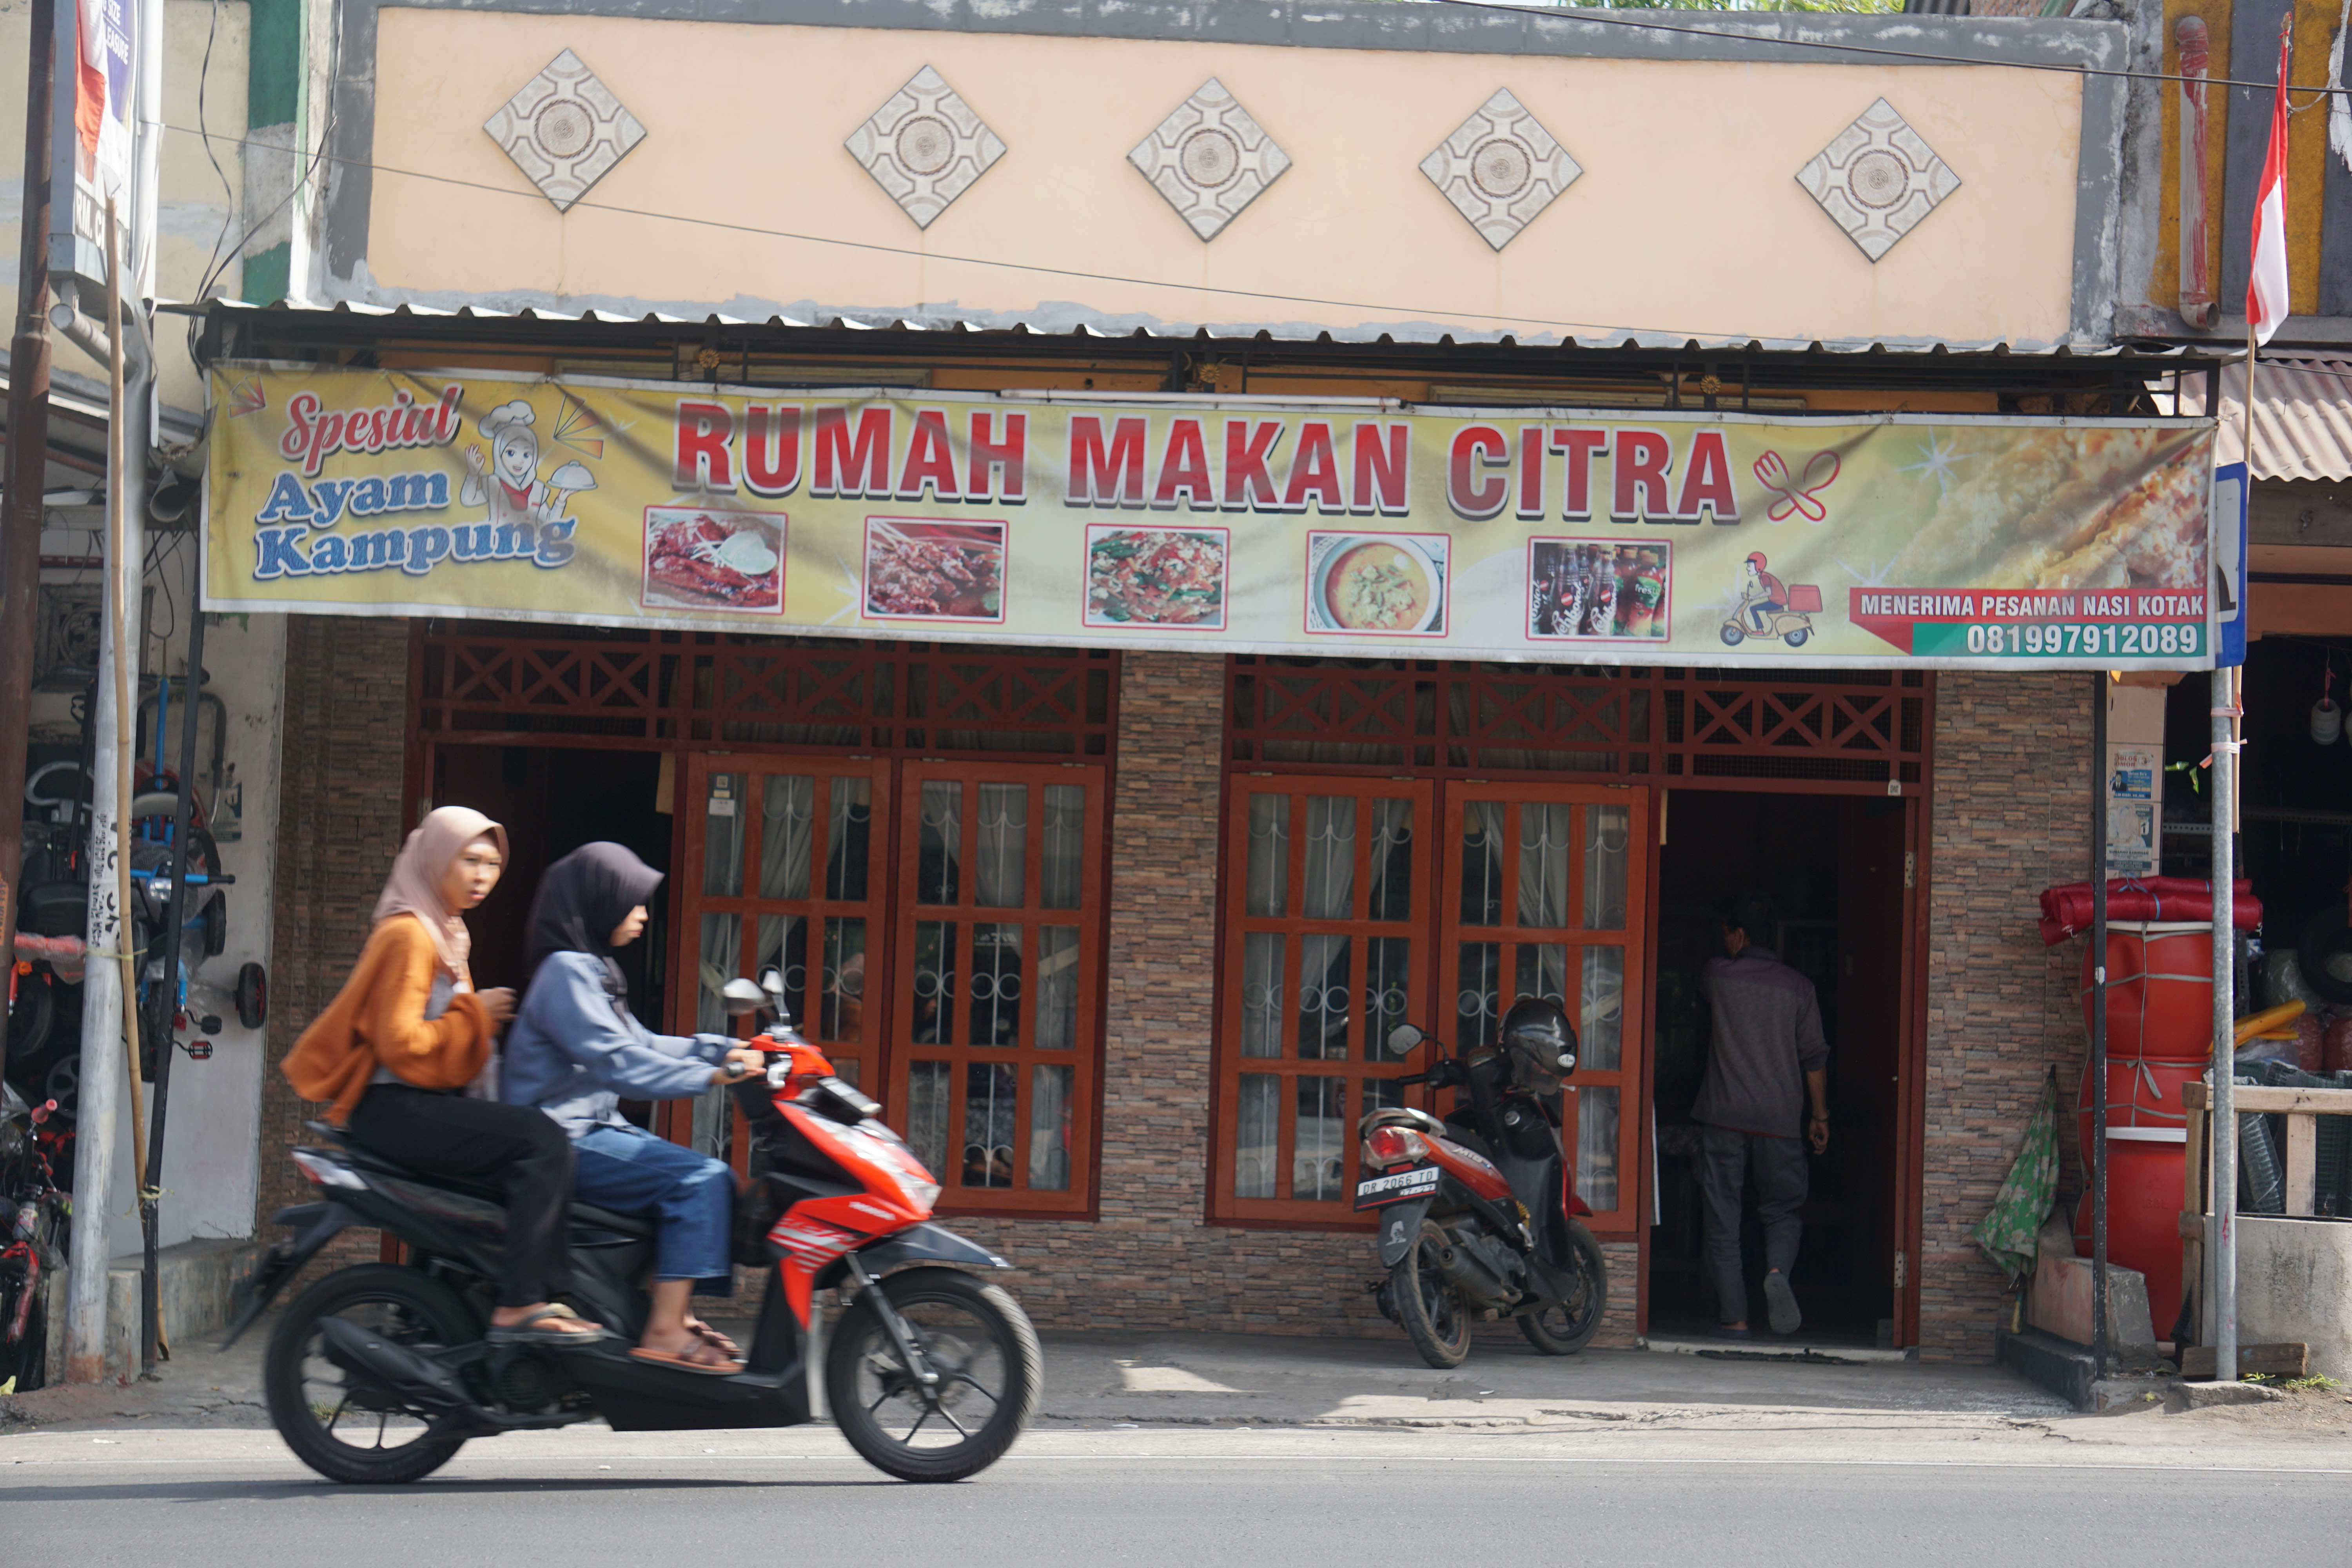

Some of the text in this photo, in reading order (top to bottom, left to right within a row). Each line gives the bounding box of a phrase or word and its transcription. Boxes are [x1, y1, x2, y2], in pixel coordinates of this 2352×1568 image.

[105, 26, 129, 65] EASURE
[279, 383, 462, 475] Spesial
[673, 399, 1740, 524] RUMAH MAKAN CITRA
[256, 471, 450, 528] Ayam
[255, 515, 578, 578] Kampung
[1861, 594, 2204, 616] MENERIMA PESANAN NASI KOTAK
[1967, 625, 2197, 654] 081997912089
[1363, 1171, 1433, 1194] DR 2066 TD
